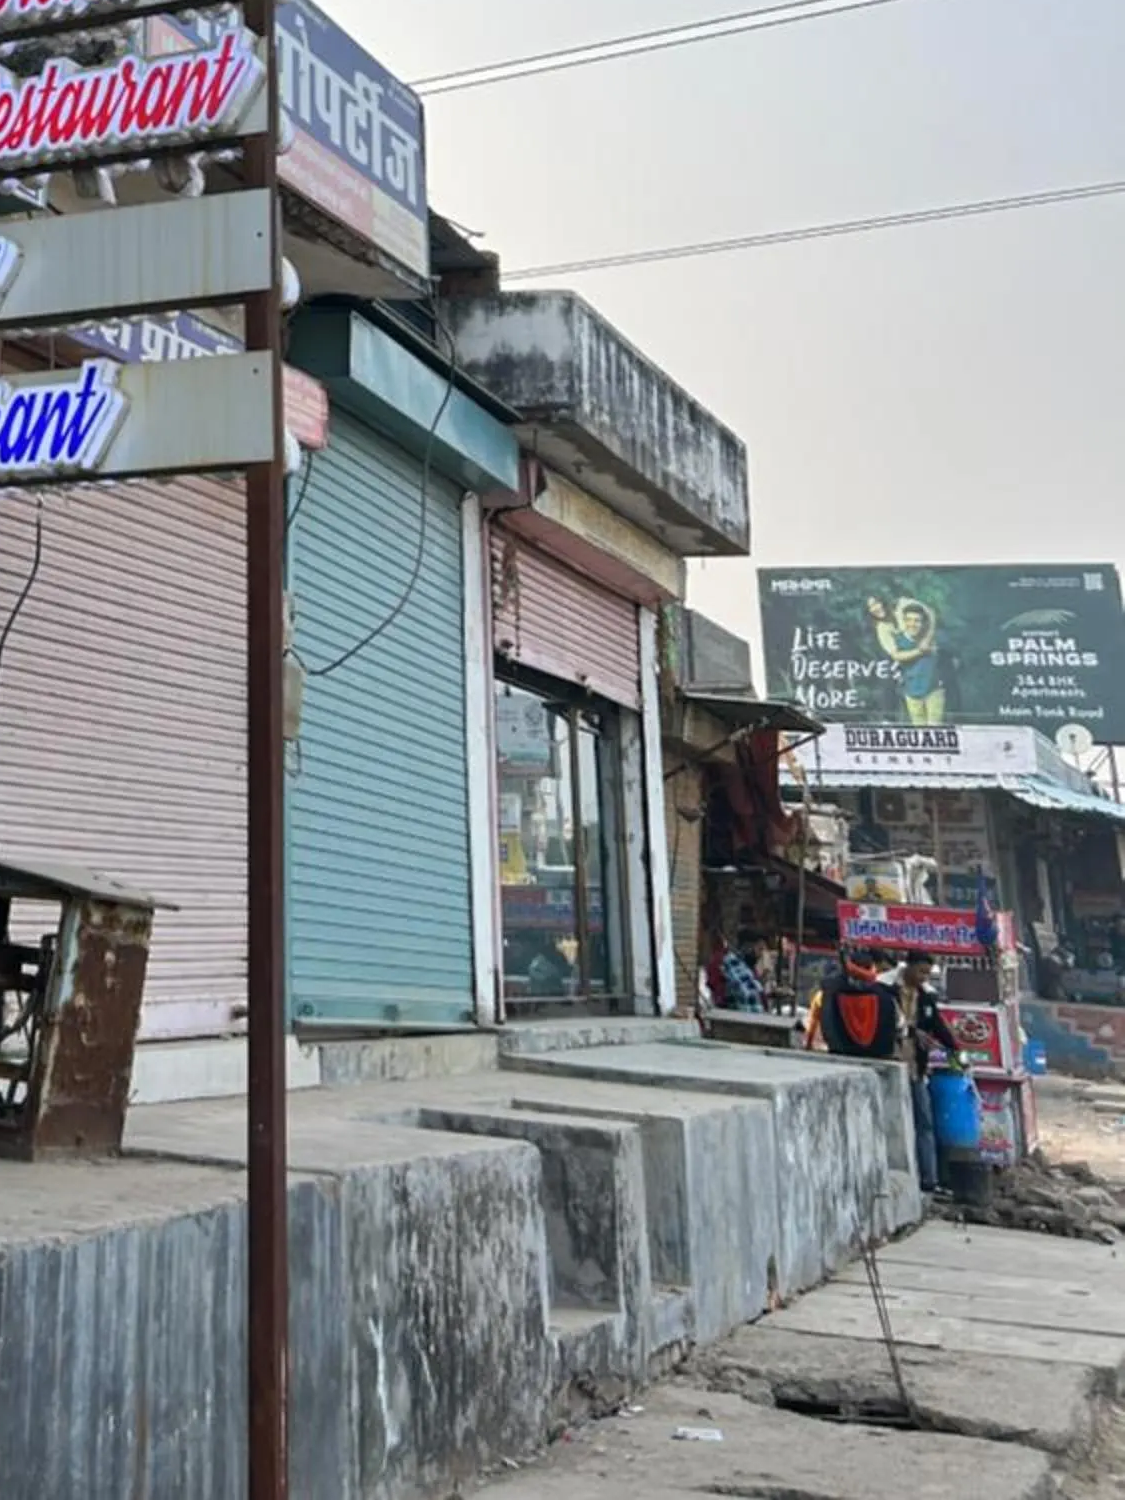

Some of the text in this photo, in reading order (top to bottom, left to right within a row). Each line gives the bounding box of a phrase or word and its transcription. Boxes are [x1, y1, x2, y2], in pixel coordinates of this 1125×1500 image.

[1007, 637, 1076, 651] PALM
[990, 651, 1099, 667] SPRINGS
[1067, 705, 1104, 719] Road
[845, 729, 959, 749] DURAGUARD
